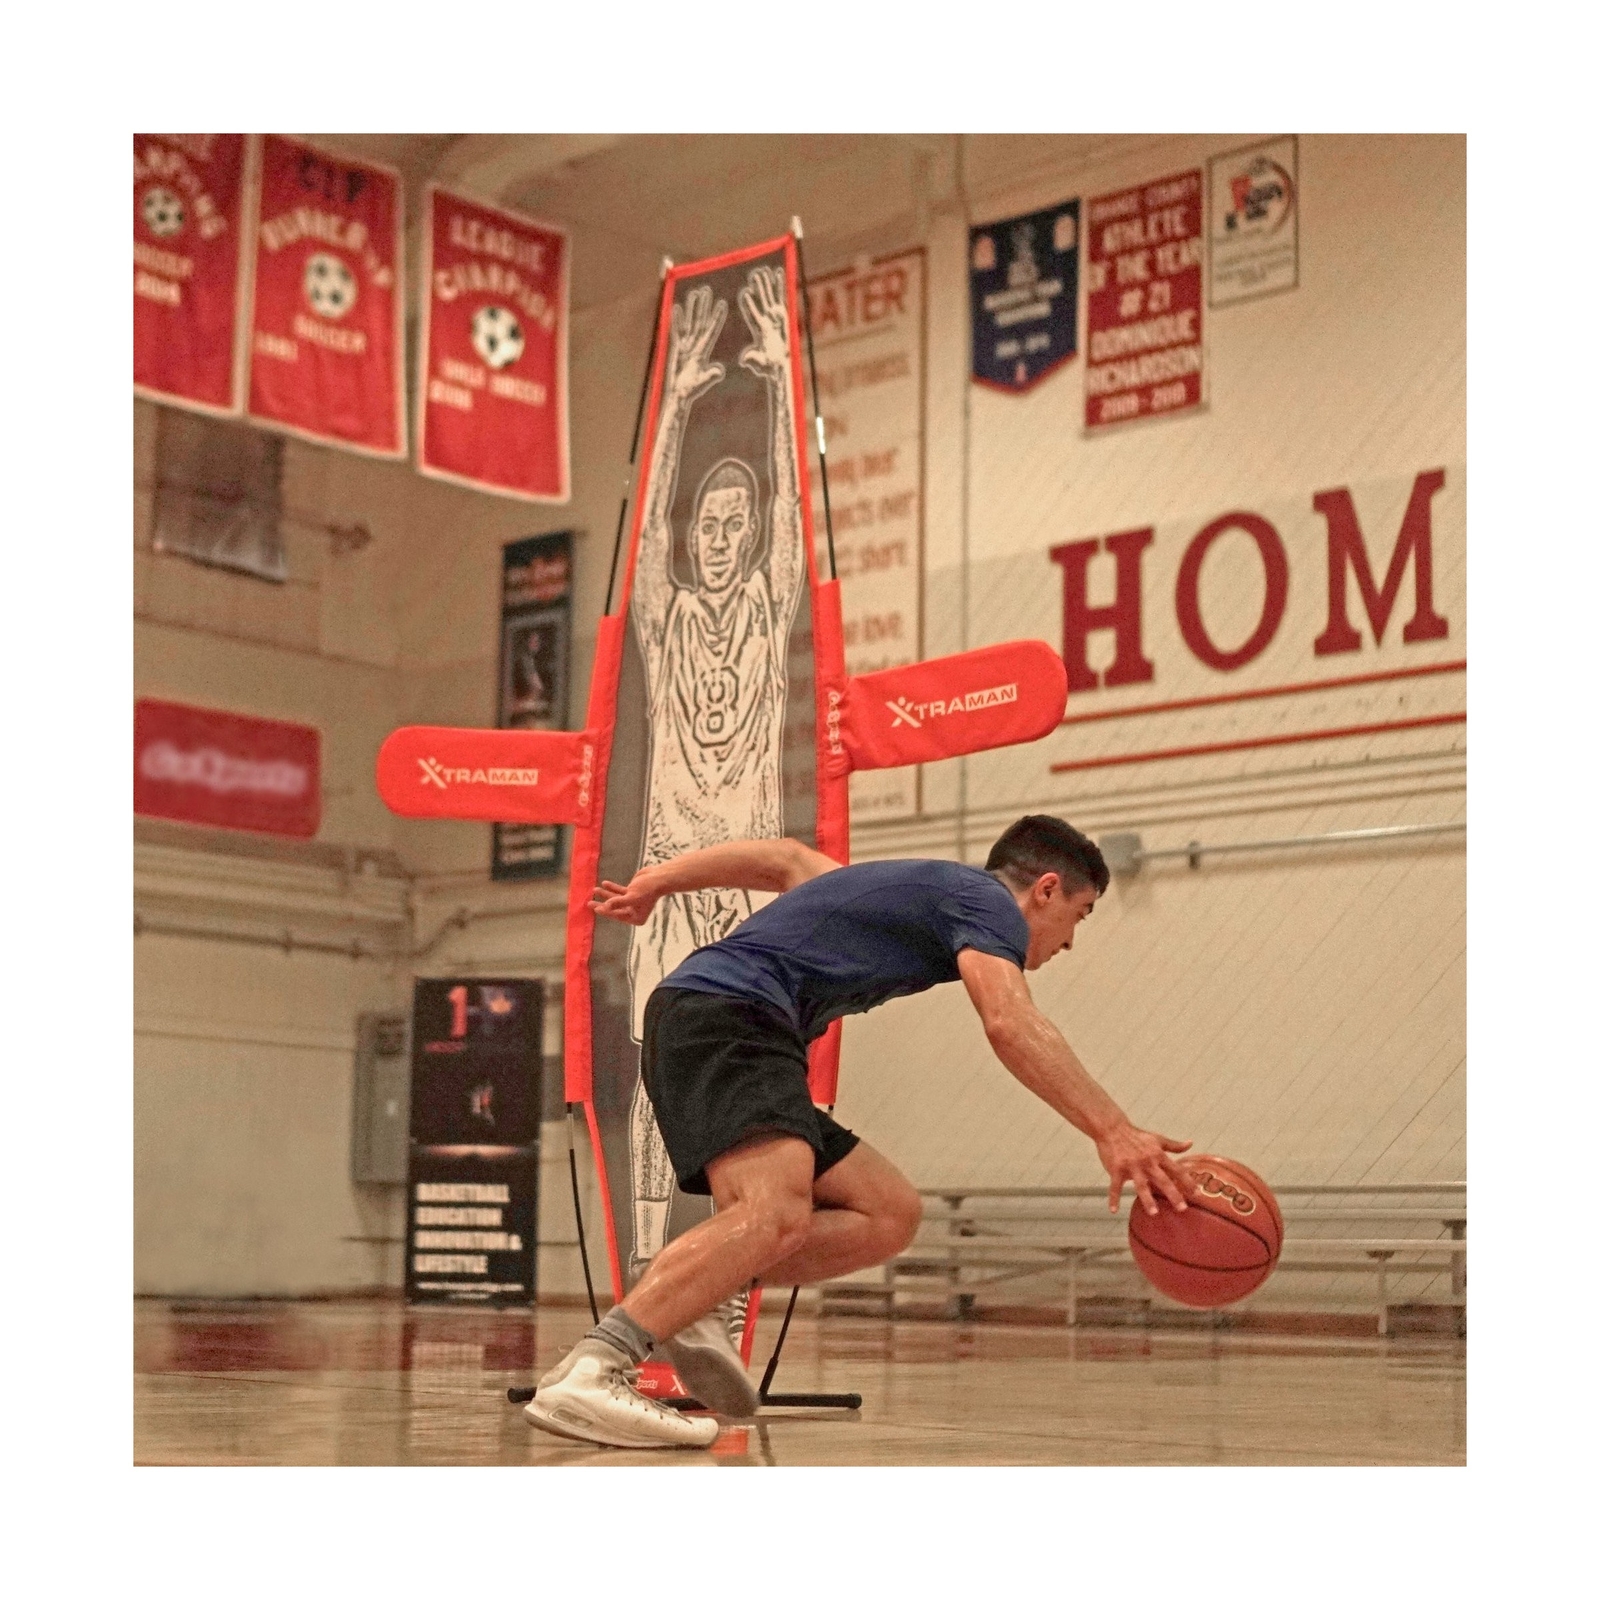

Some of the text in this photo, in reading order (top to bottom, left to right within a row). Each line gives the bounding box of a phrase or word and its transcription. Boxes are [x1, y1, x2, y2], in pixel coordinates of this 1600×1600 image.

[451, 214, 546, 275] LEAGUE
[1102, 205, 1187, 253] ATHLETE
[1115, 250, 1151, 286] THE
[1089, 308, 1197, 363] DOMINIQUE
[1086, 349, 1201, 393] RICHARDSON
[1050, 465, 1450, 696] HOM
[884, 682, 1018, 729] XTRAMAN
[417, 757, 539, 790] XTRAMAN
[416, 1183, 510, 1203] BASKETBALL
[415, 1207, 503, 1226] EDUCATION
[414, 1231, 508, 1251] INNOVATION
[413, 1254, 488, 1274] LIFESTYLE
